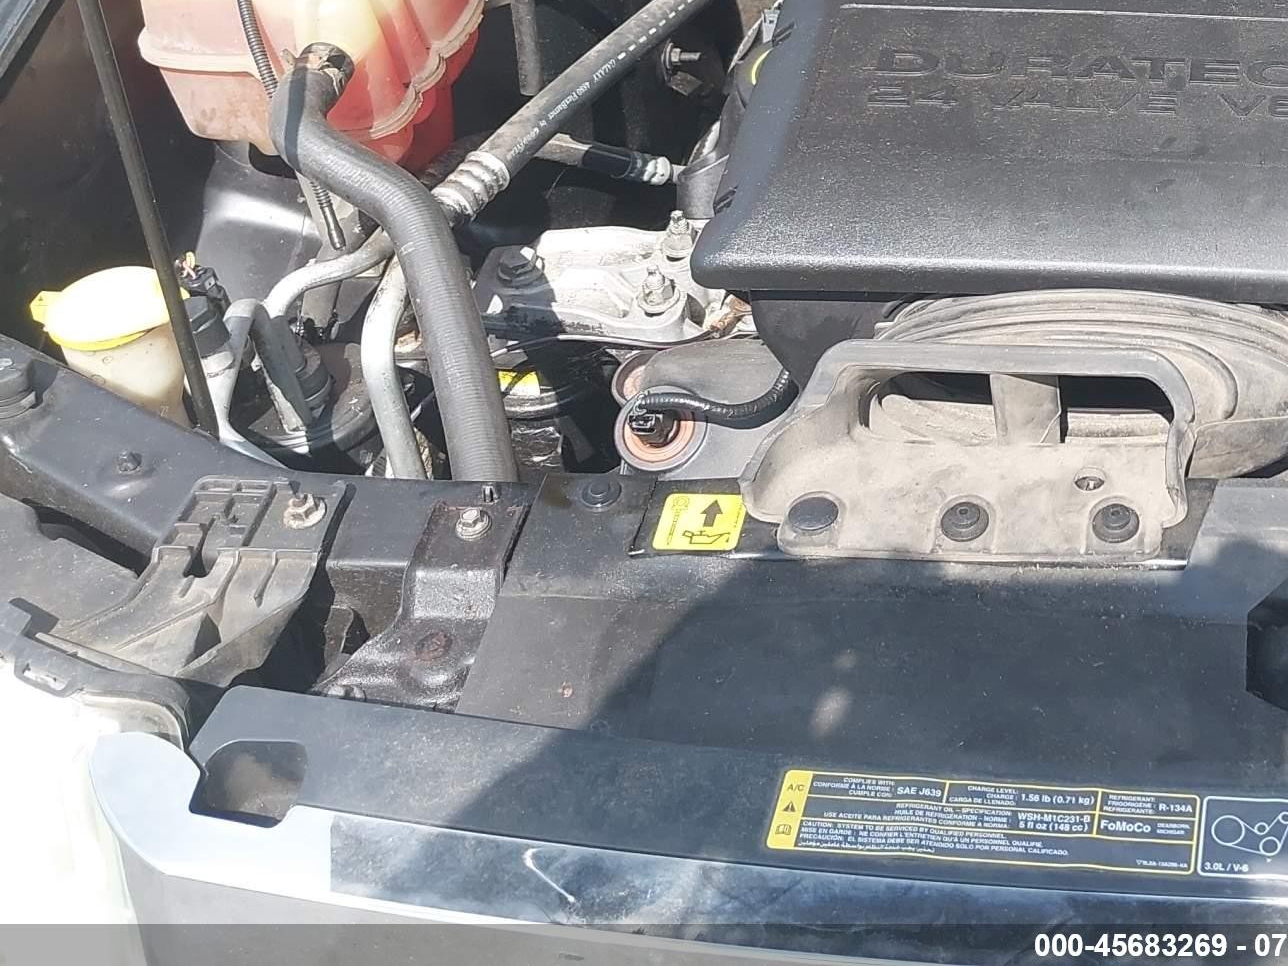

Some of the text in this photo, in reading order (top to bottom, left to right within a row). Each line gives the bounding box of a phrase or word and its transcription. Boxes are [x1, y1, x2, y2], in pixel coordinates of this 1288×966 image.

[866, 83, 959, 110] 24
[991, 88, 1179, 117] VALVE
[897, 787, 942, 797] SAE J639
[1021, 794, 1094, 806] 1.56 lb (0.71 kg)
[896, 803, 942, 811] REFRIGERANT
[1158, 804, 1192, 813] R-134A
[1018, 812, 1091, 823] WSH-M1C231-B
[1049, 822, 1070, 832] (148
[1072, 824, 1088, 832] cc)
[1100, 820, 1151, 833] FoMoCo
[1204, 862, 1225, 871] 3.0L
[1233, 864, 1249, 872] V-6
